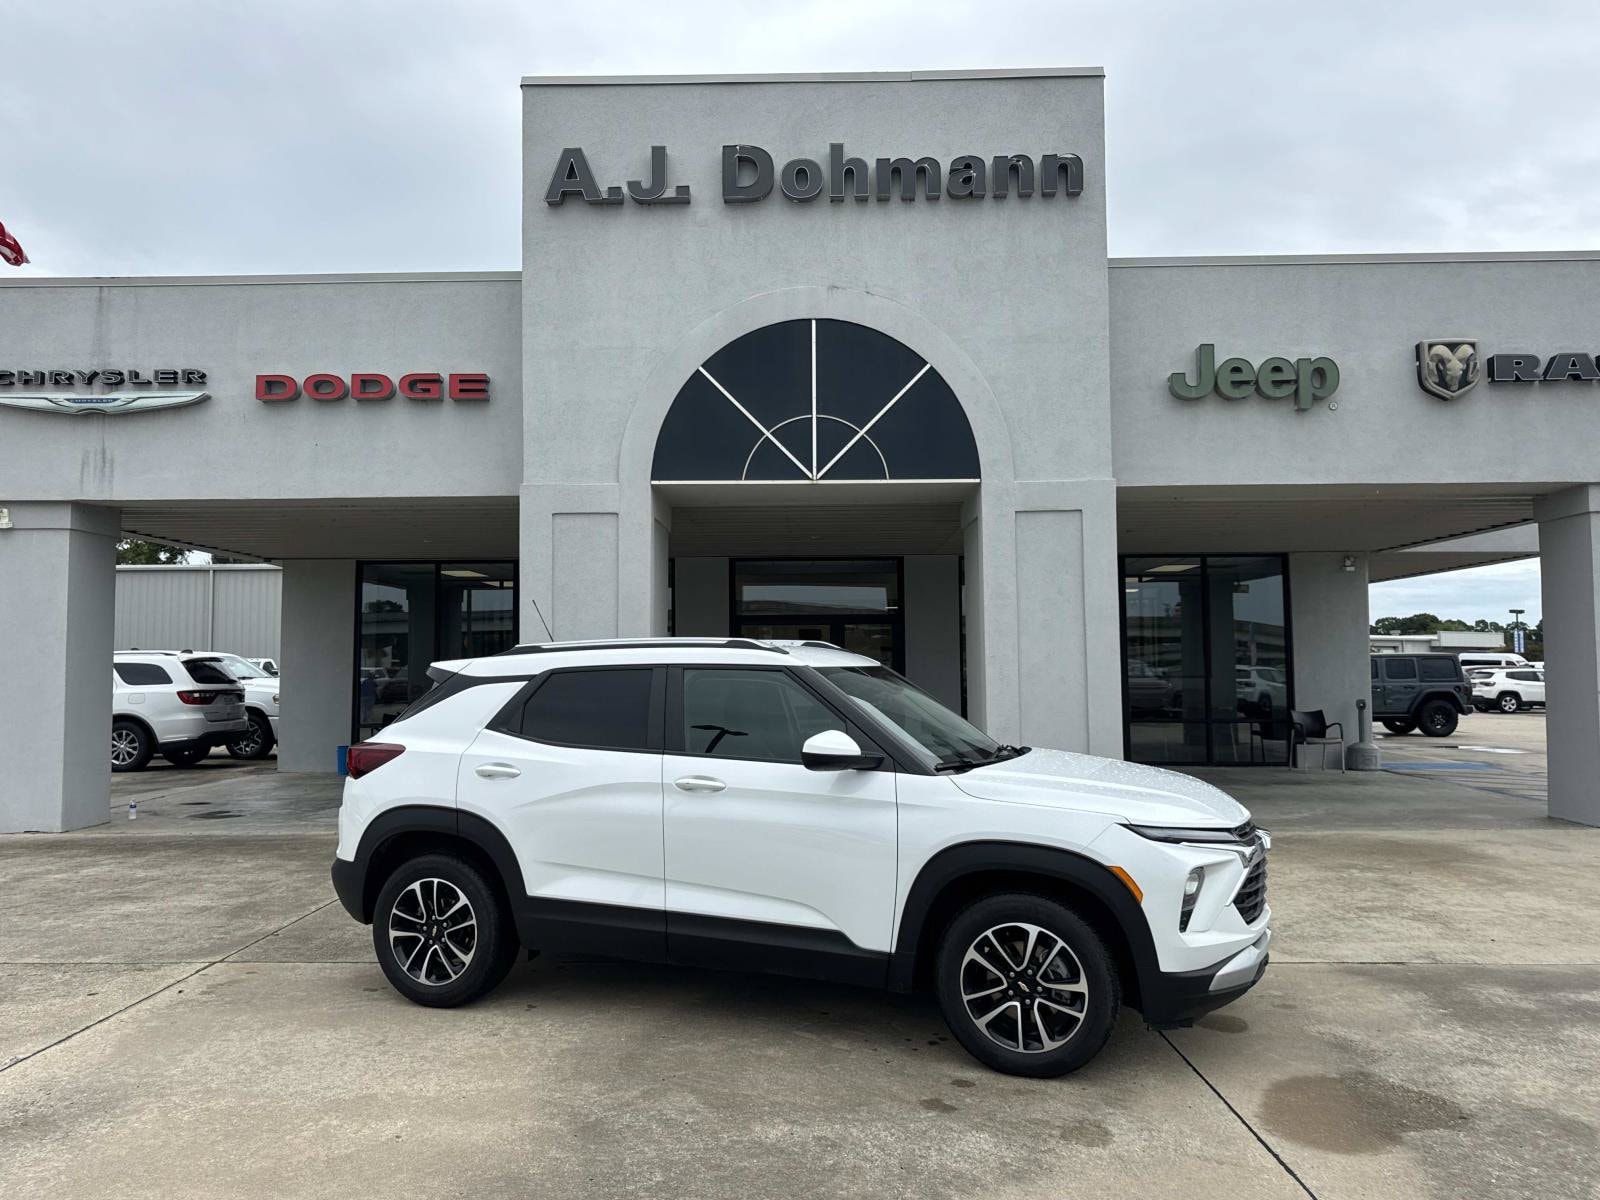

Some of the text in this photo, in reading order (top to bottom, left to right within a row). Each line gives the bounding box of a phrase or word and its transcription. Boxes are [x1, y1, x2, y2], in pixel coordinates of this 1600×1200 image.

[544, 143, 1084, 205] A.J. Dohmann
[256, 373, 491, 401] DODGE
[1168, 343, 1340, 411] Jeep
[1487, 352, 1600, 382] RA
